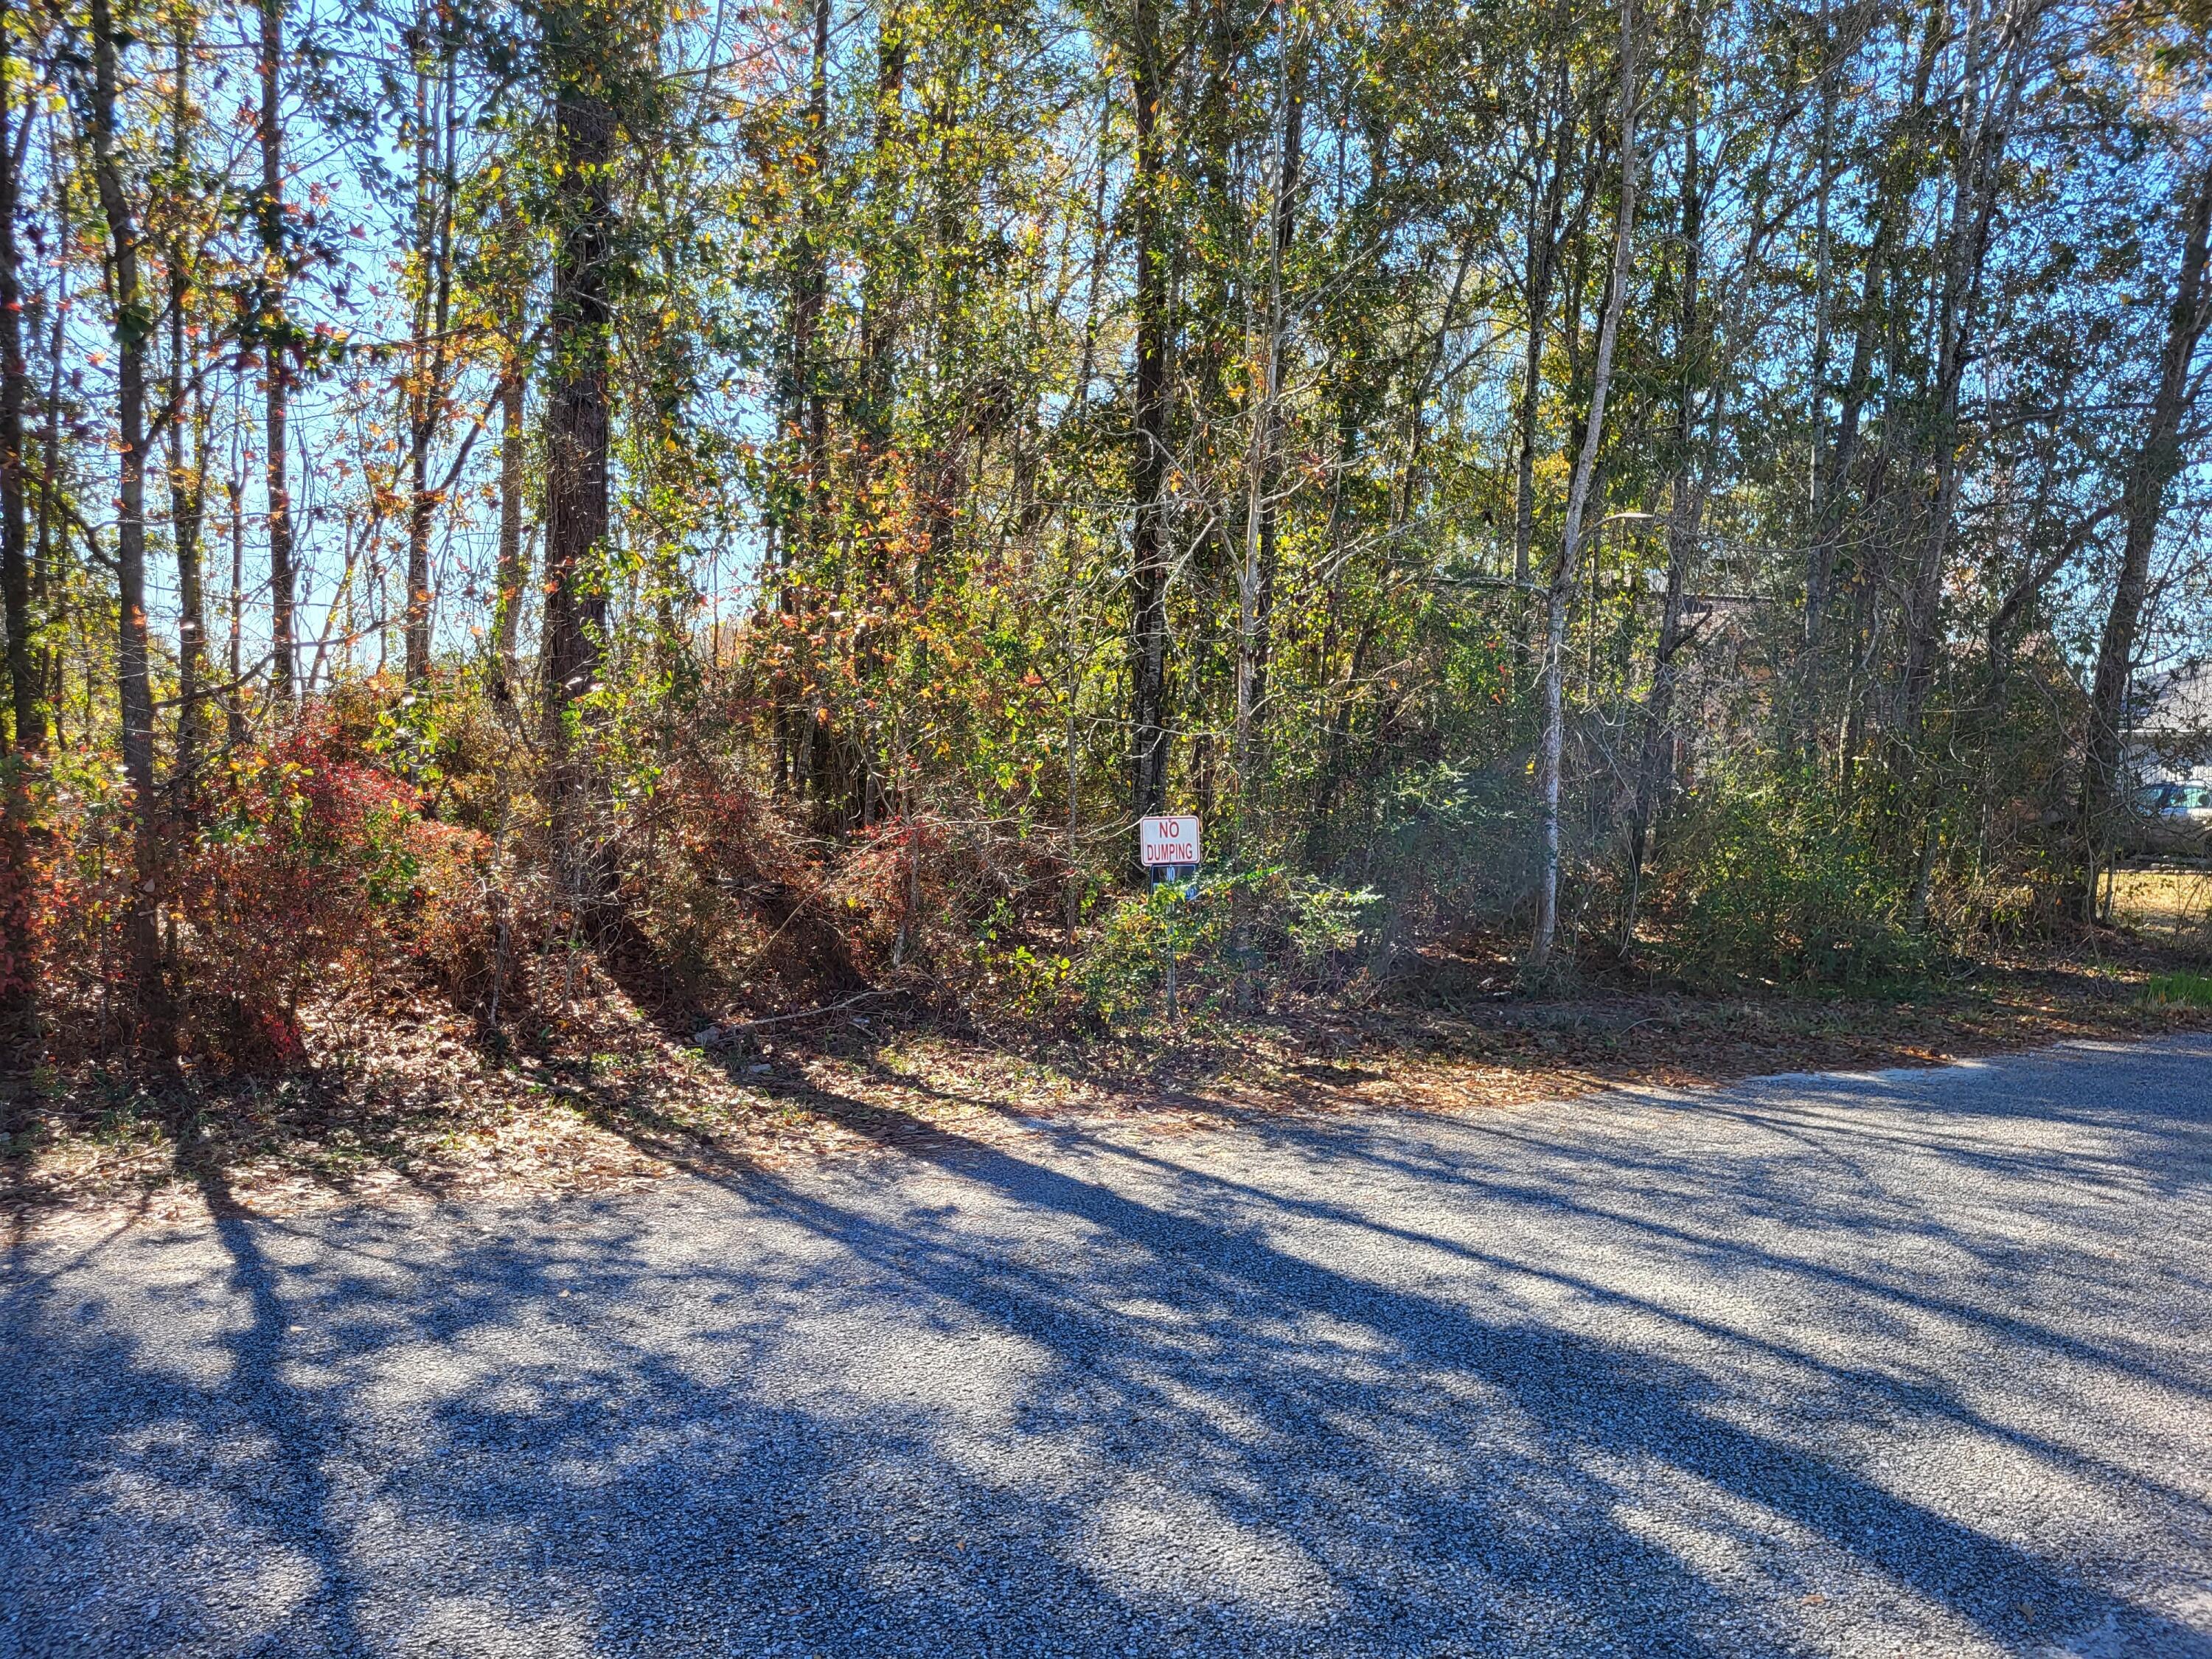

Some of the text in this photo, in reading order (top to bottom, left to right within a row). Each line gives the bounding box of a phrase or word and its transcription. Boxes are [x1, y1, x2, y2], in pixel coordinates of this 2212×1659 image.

[1159, 821, 1179, 838] NO
[1147, 844, 1192, 860] DUMPING
[1166, 867, 1175, 881] NO
